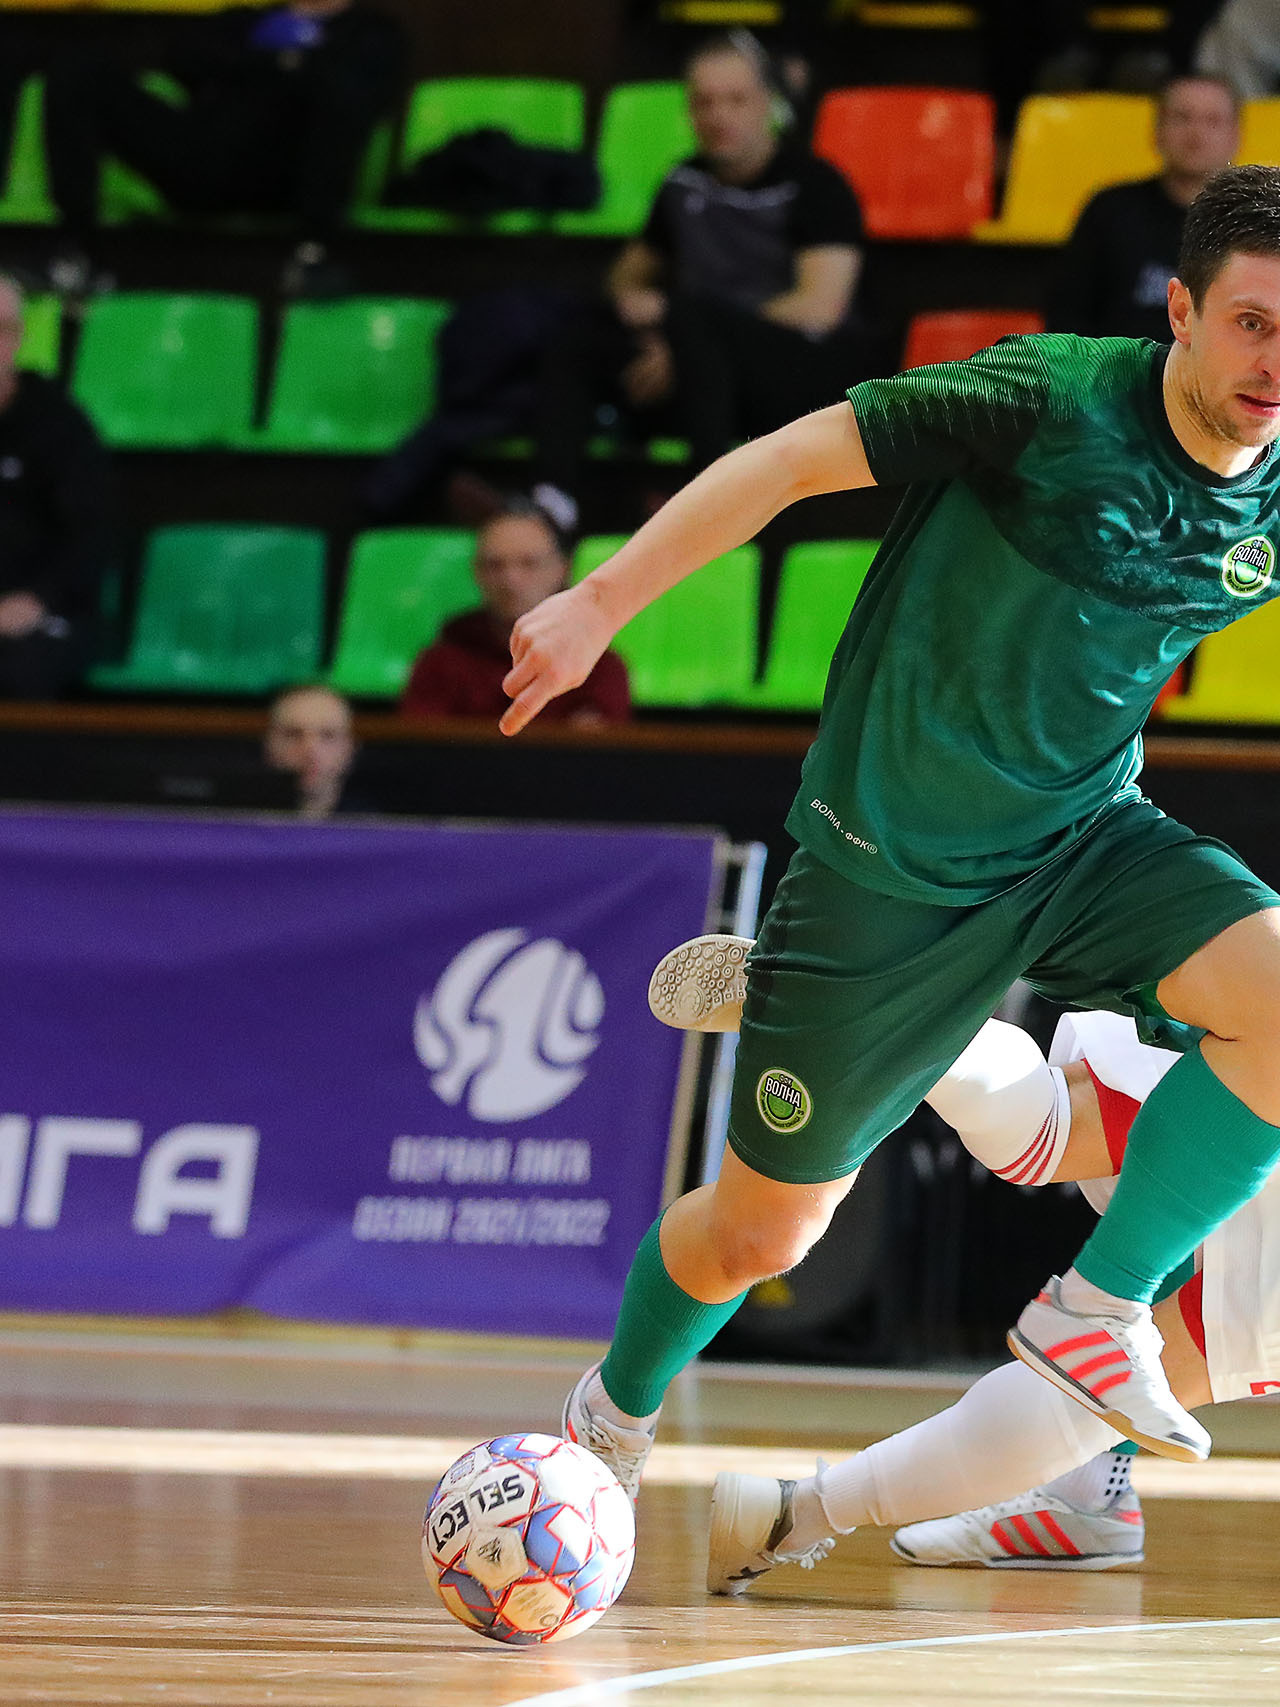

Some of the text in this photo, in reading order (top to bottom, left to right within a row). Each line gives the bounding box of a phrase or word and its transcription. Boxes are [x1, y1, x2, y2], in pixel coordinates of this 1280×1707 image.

[1233, 546, 1268, 570] ВОЛНА
[810, 799, 841, 830] ВОЛНА
[766, 1078, 800, 1107] ВОЛНА
[0, 1112, 260, 1238] ГА
[431, 1473, 526, 1554] SELECT
